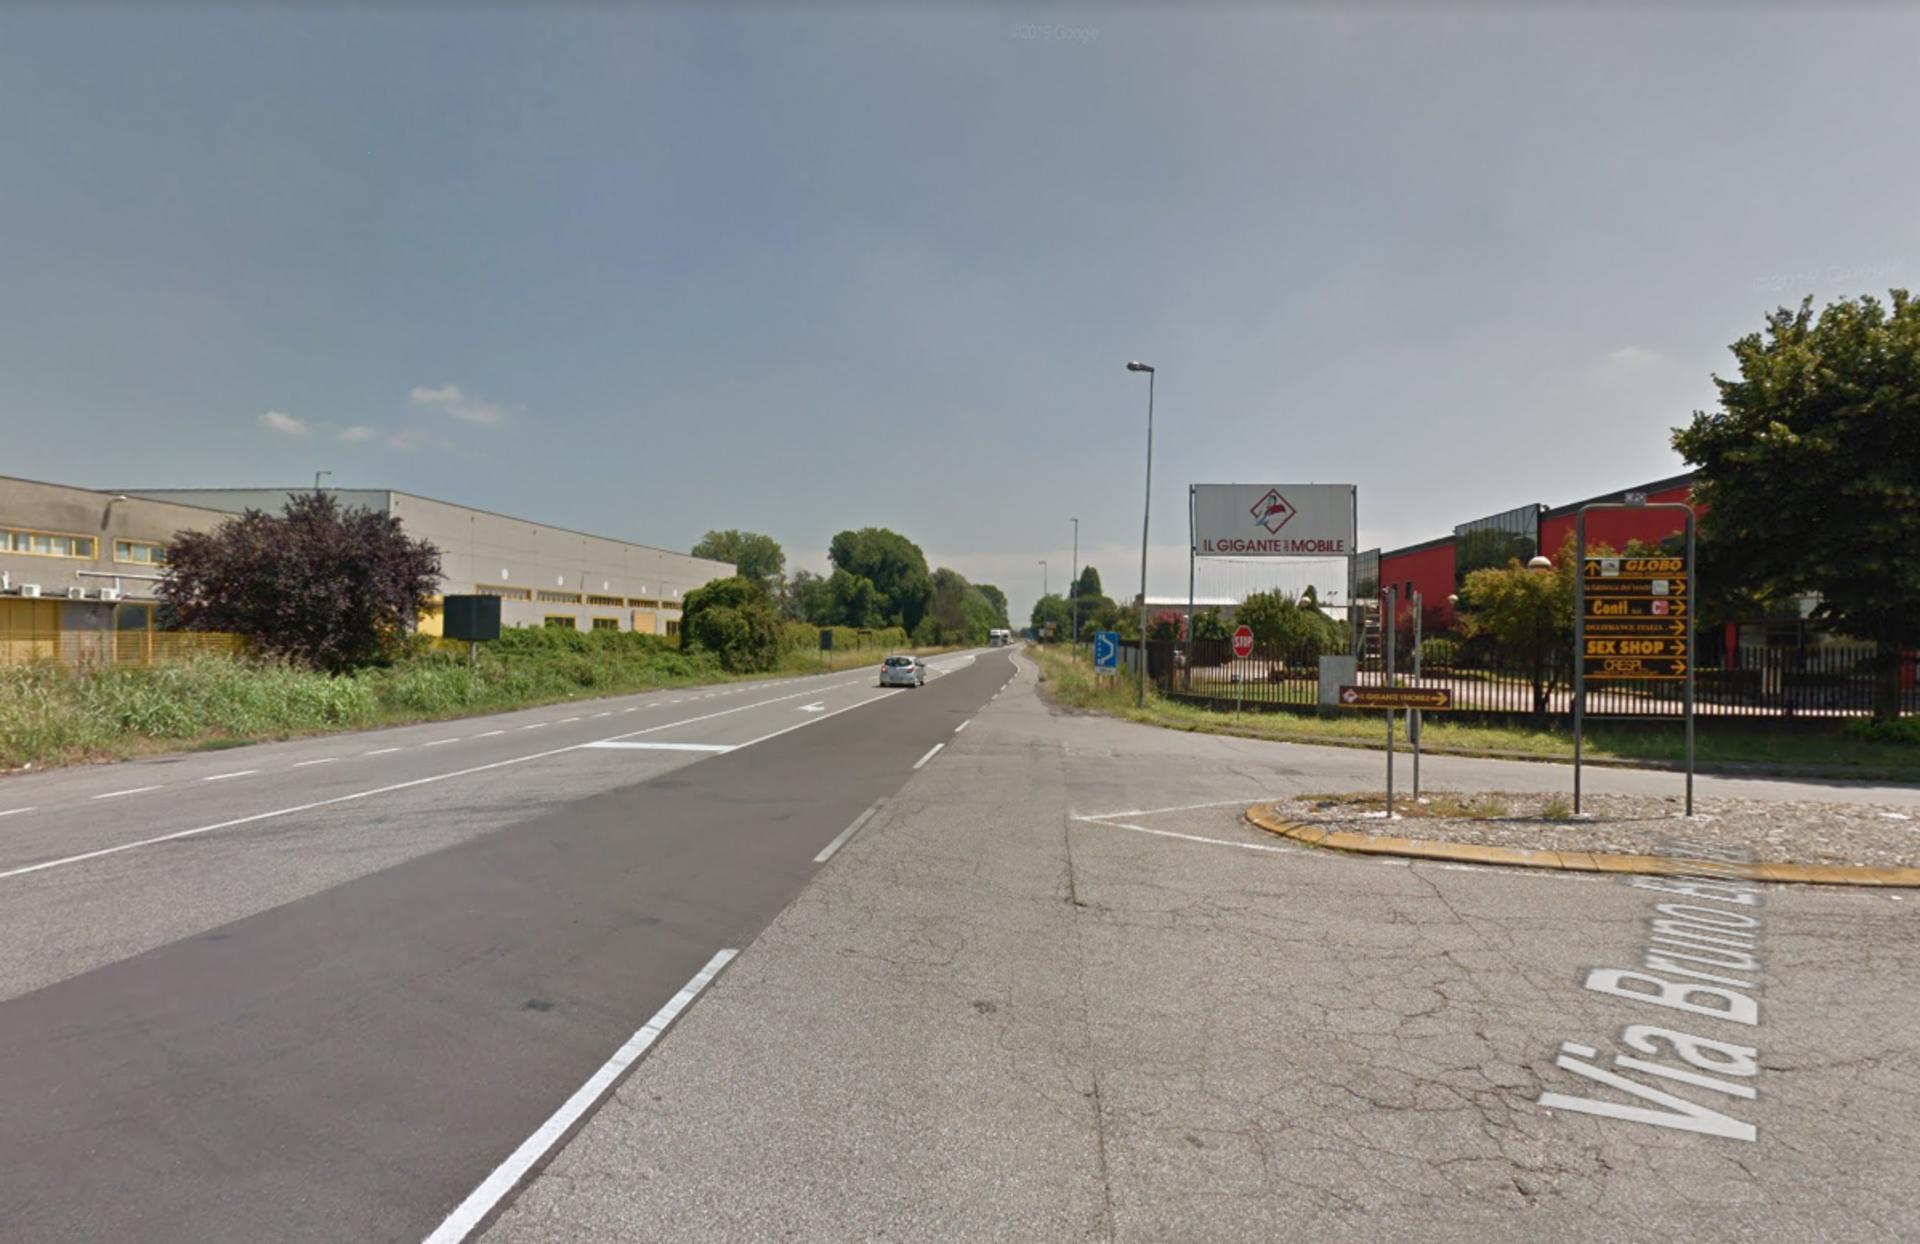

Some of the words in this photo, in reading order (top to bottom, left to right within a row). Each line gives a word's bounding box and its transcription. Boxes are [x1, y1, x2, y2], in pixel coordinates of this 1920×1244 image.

[1203, 539, 1214, 552] IL
[1217, 539, 1281, 552] GIGANTE
[1291, 539, 1344, 552] MOBILE
[1625, 560, 1683, 572] GLOBO
[1593, 600, 1628, 614] Conti
[1232, 635, 1252, 648] STOP
[1587, 640, 1616, 654] SEX
[1620, 640, 1664, 654] SHOP
